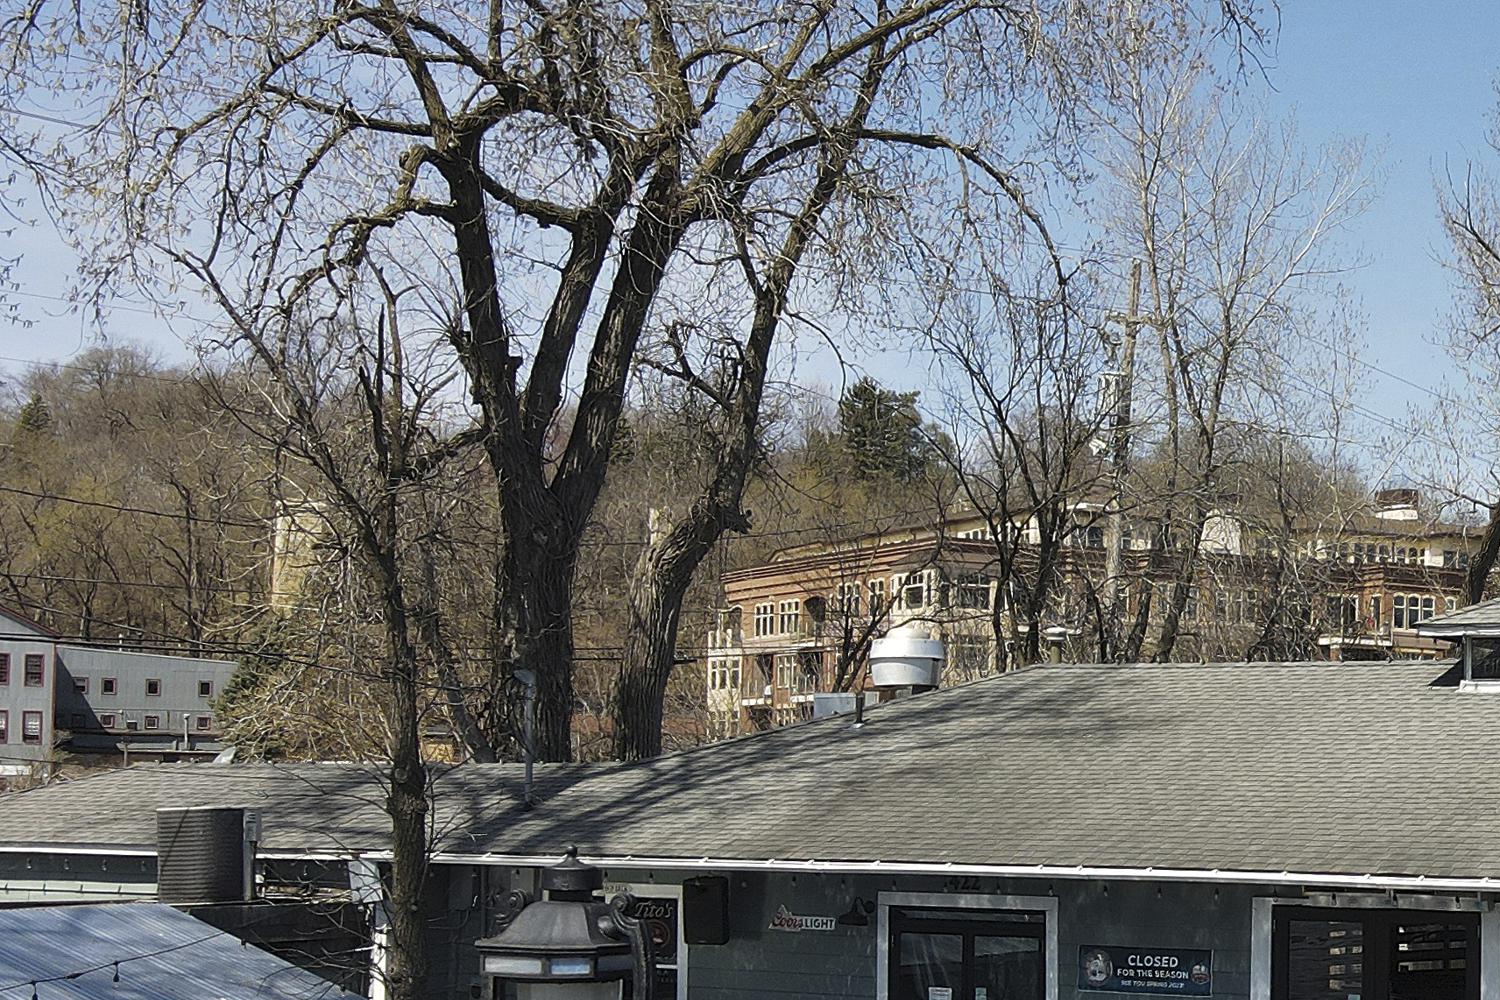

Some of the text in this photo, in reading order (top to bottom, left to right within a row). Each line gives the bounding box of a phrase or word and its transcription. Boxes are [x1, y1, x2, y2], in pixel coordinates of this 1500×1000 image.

[634, 901, 674, 918] Tito's
[772, 911, 835, 929] Coors LIGHT
[1127, 954, 1179, 968] CLOSED
[1117, 968, 1189, 979] FOR THE SEASON
